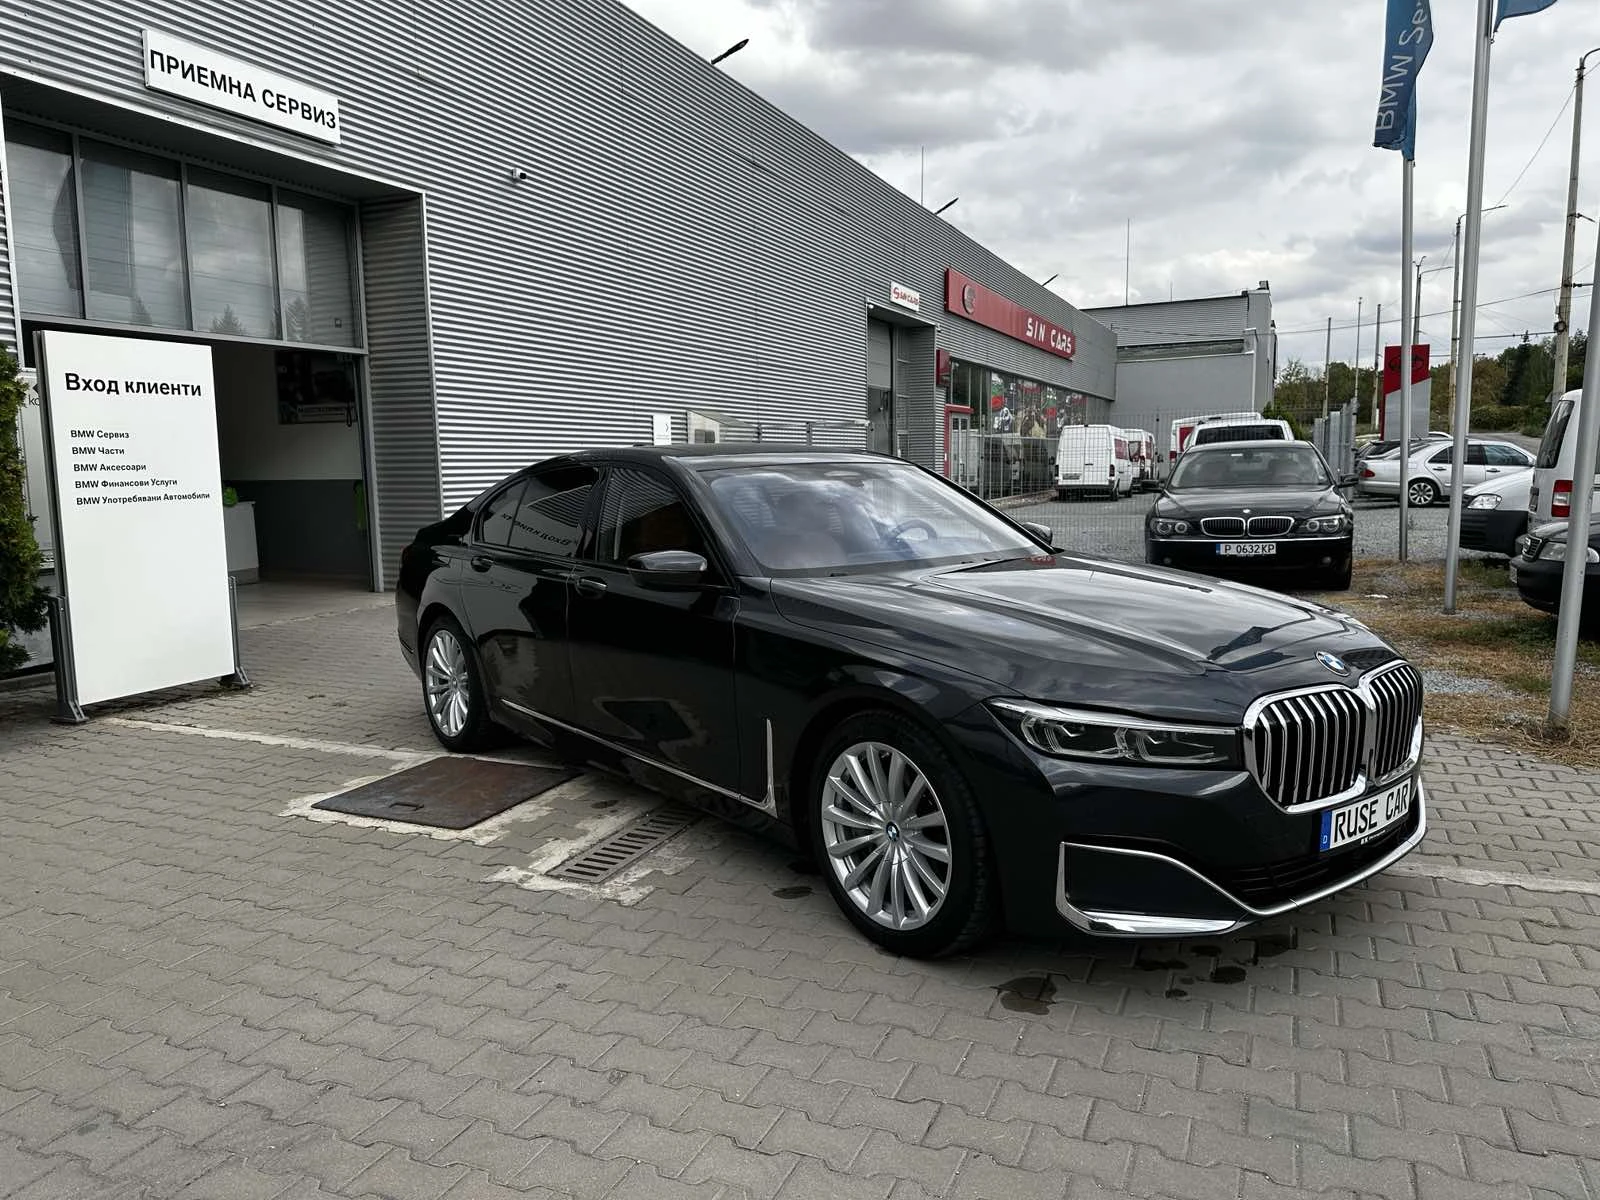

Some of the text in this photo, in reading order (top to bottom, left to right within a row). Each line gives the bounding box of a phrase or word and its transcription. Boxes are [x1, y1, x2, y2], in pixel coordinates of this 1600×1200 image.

[150, 49, 337, 129] ПРИЕМНА СЕРВИЗ
[1375, 55, 1413, 130] BMW
[1026, 317, 1072, 353] SIN CARS
[64, 372, 202, 397] Вход клиенти
[70, 429, 130, 440] BMW Сервиз
[71, 446, 125, 455] BMW Части
[73, 463, 147, 472] BMW Аксесоари
[74, 478, 178, 489] BMW Финансови Услуги
[76, 492, 210, 506] BMW Употребявани Автомобили
[1224, 544, 1232, 554] P
[1334, 799, 1379, 844] RUSE
[1386, 783, 1409, 821] CAR
